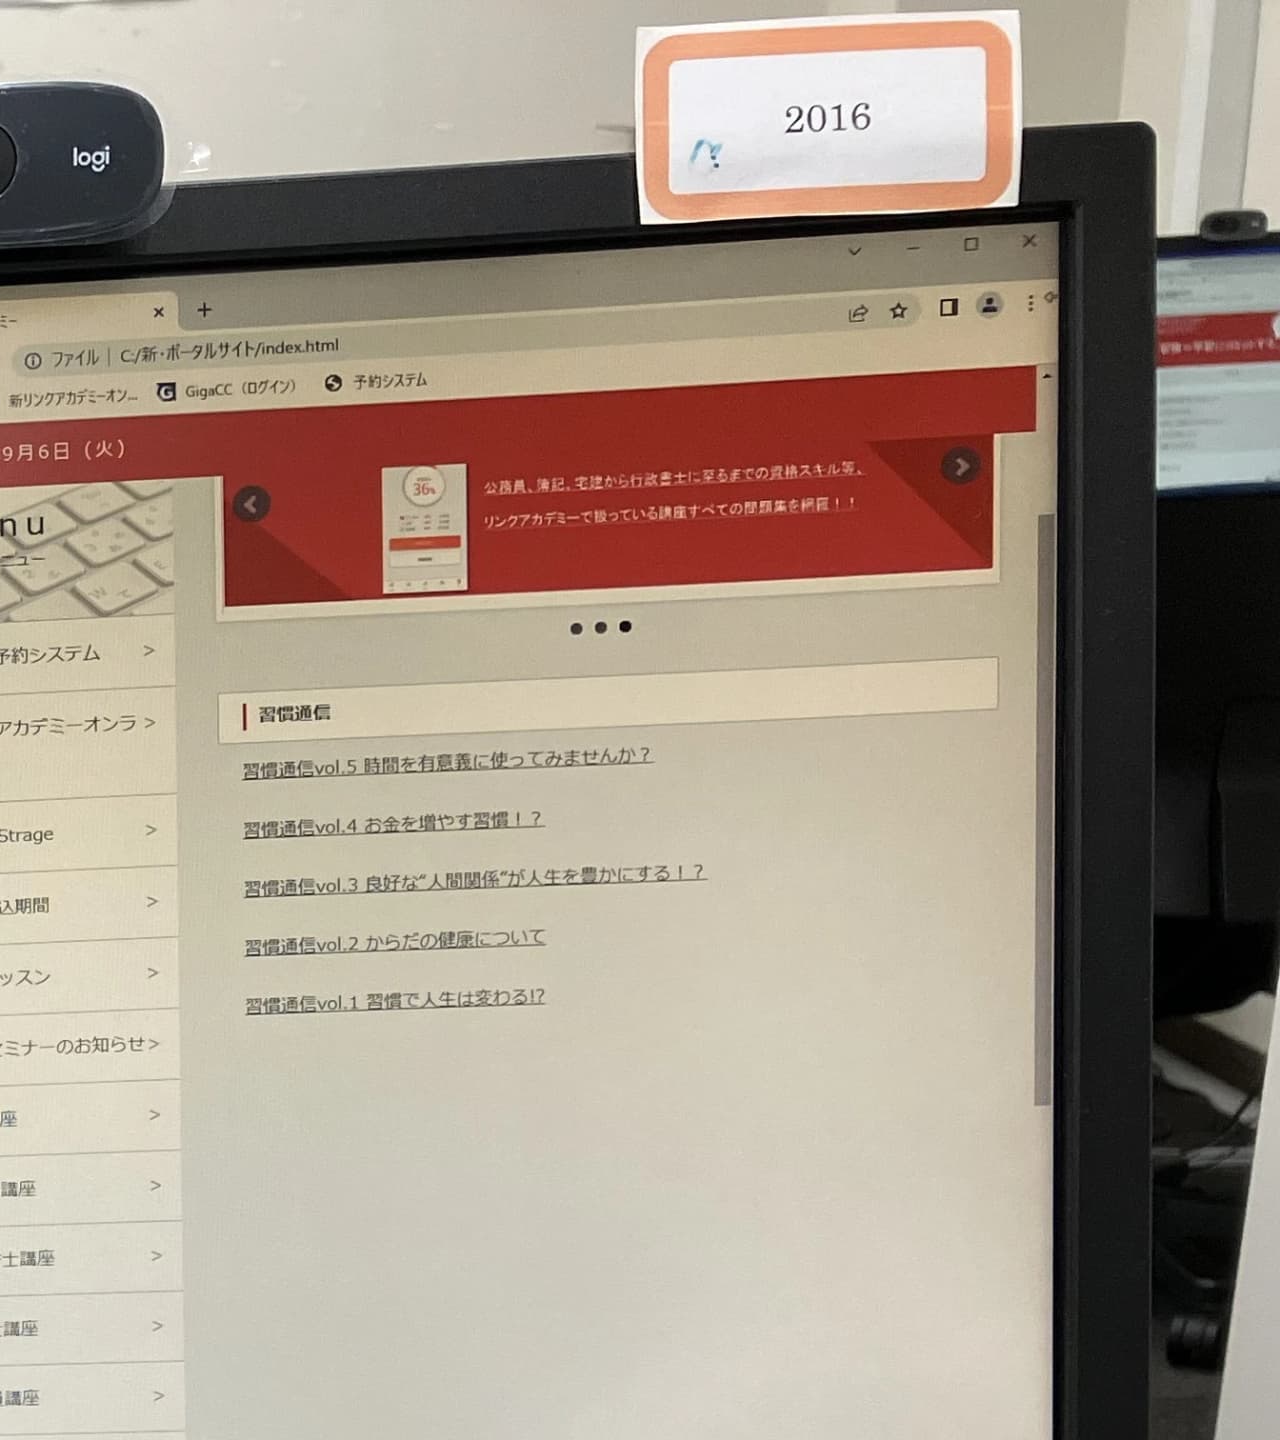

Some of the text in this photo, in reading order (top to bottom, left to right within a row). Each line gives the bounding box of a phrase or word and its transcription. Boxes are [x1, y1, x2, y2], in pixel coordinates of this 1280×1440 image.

[784, 102, 872, 135] 2016
[72, 145, 110, 174] logi
[53, 350, 100, 367] ファイル
[353, 373, 428, 390] 予約システム
[258, 704, 331, 724] 習慣通信
[365, 929, 547, 953] からだの健康について
